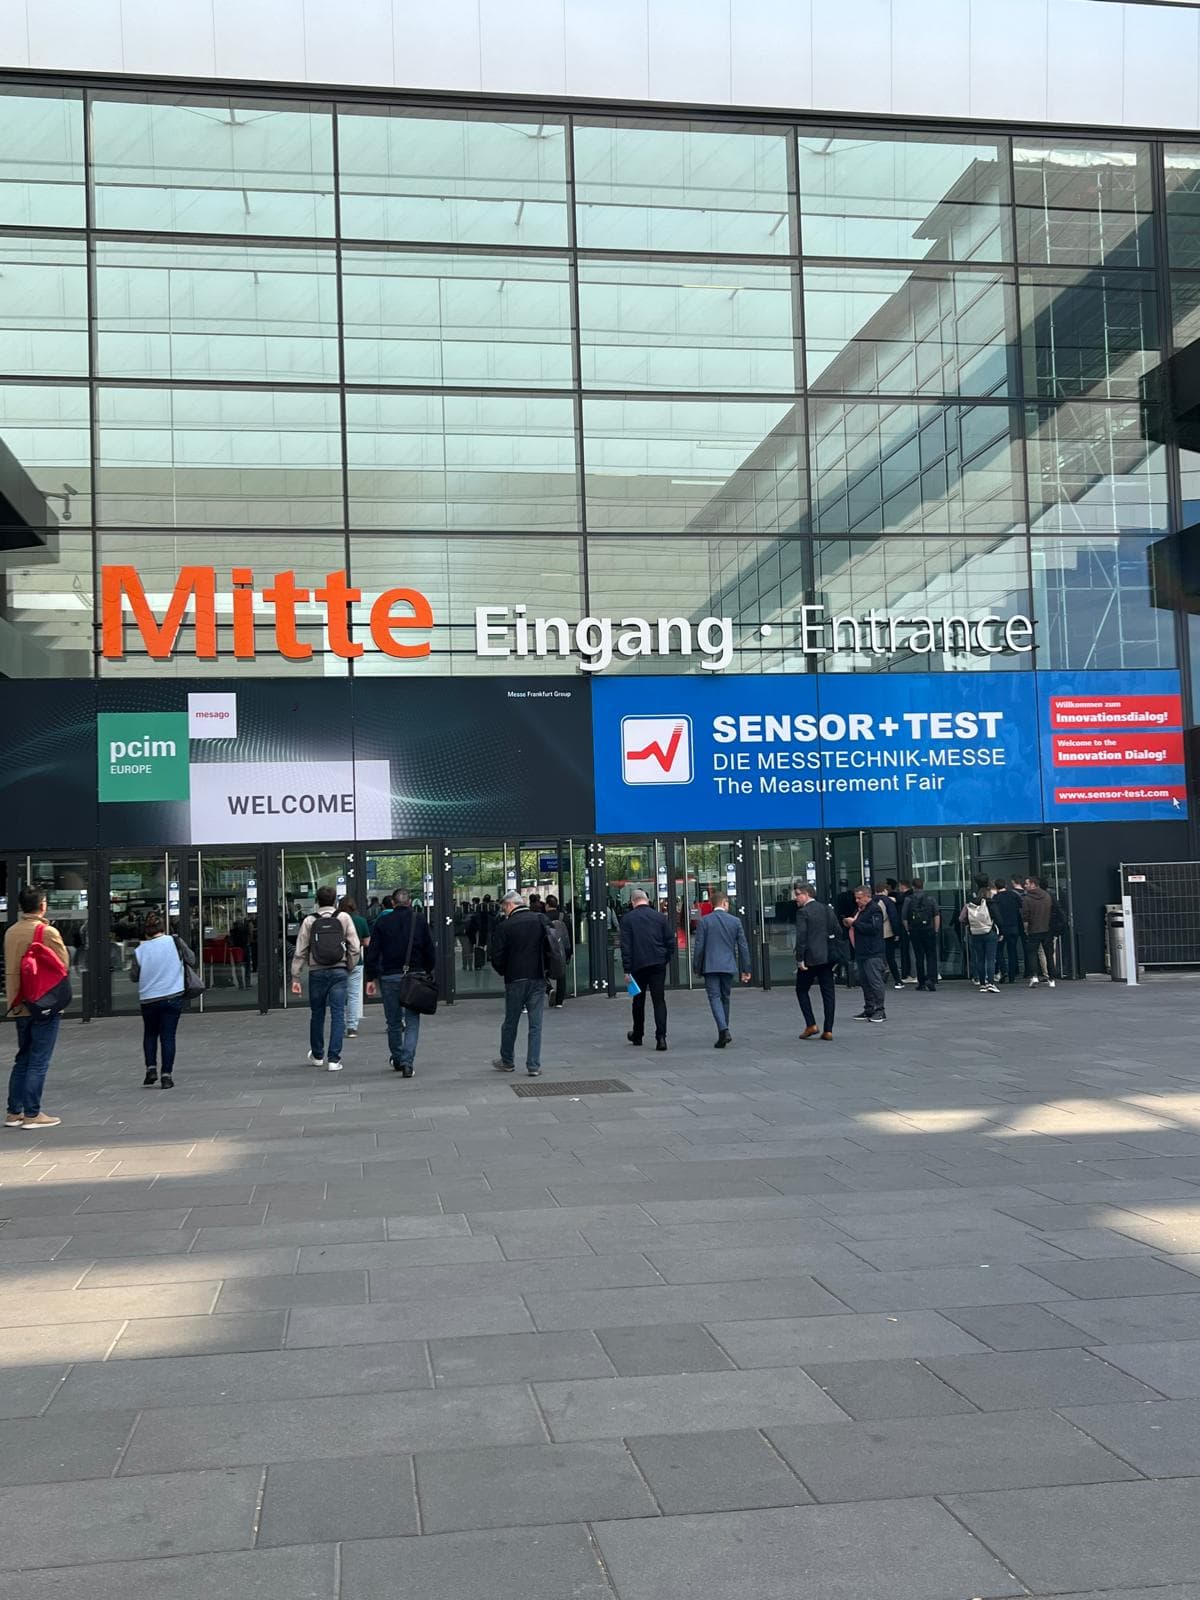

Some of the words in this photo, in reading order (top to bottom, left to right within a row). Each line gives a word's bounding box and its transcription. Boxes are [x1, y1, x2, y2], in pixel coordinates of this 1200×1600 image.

[101, 565, 434, 660] Mitte
[475, 604, 734, 671] Eingang
[800, 604, 1034, 654] Entrance
[195, 710, 230, 720] mesago
[1056, 712, 1168, 724] Innovationsdialog!
[110, 736, 176, 762] pcim
[713, 752, 751, 771] DIE
[757, 748, 1006, 770] MESSTECHNIK-MESSE
[1058, 750, 1122, 760] Innovation
[1125, 750, 1166, 762] Dialog!
[110, 764, 152, 774] EUROPE
[714, 776, 752, 794] The
[758, 774, 899, 793] Measurement
[905, 773, 945, 790] Fair
[227, 795, 354, 816] WELCOME
[1059, 790, 1169, 800] www.sensor-test.com
